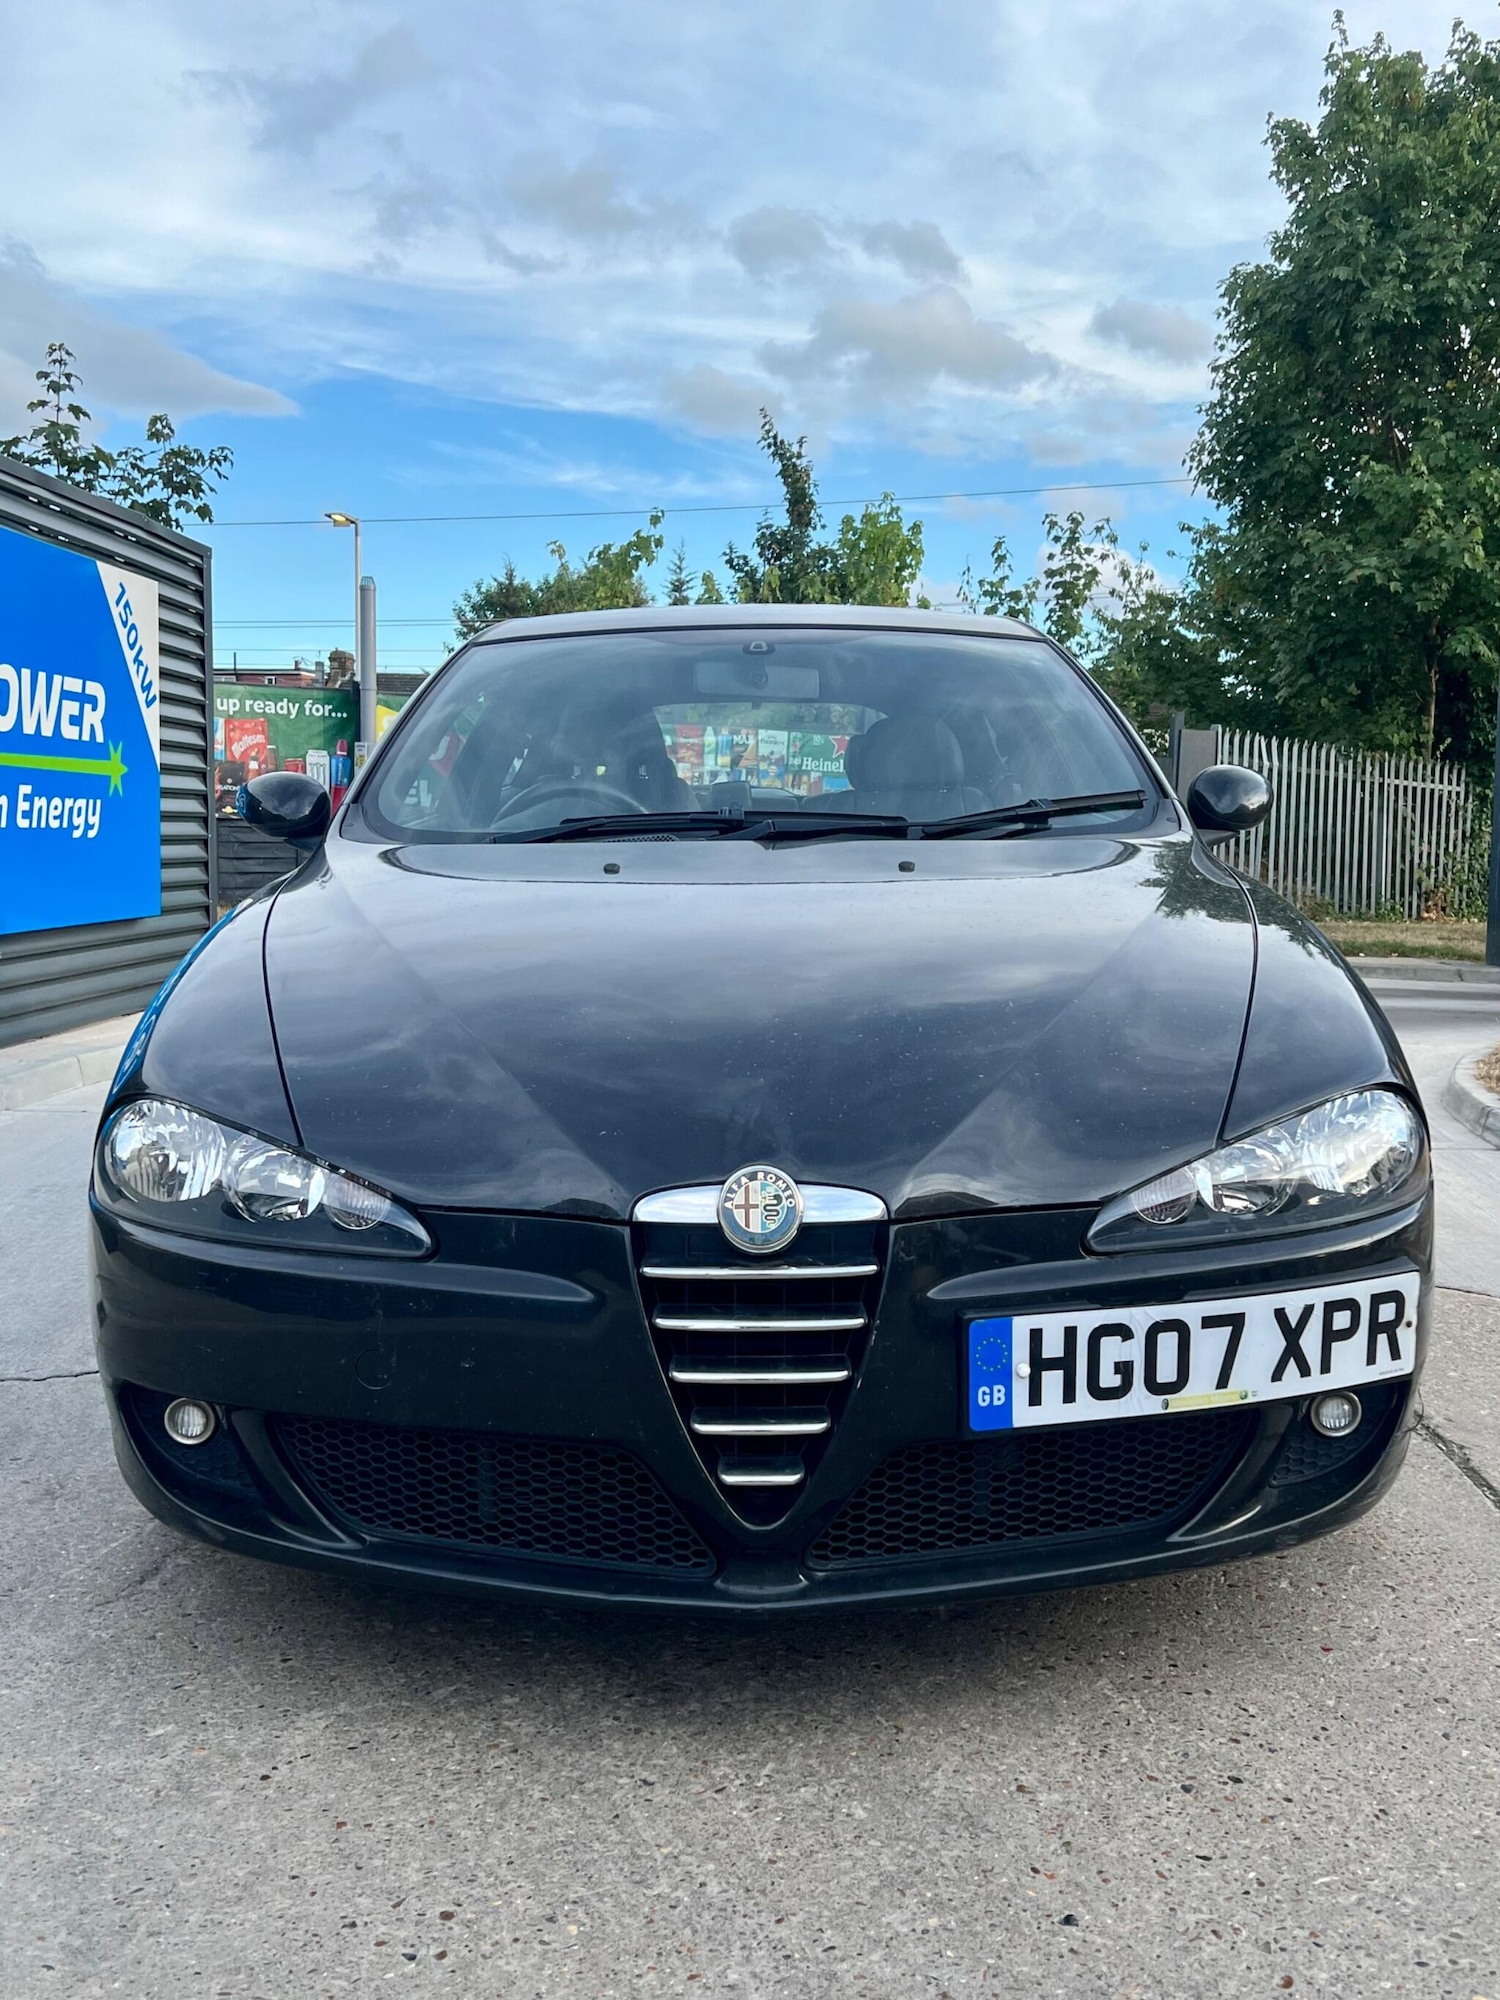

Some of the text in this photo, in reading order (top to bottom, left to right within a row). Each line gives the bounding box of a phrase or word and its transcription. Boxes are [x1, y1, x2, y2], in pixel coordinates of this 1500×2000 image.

[115, 581, 157, 709] 150kW
[216, 698, 348, 719] up ready for...
[801, 756, 844, 773] Heine
[16, 784, 102, 839] Energy
[724, 1171, 796, 1209] ALFA ROMEO
[1270, 1290, 1406, 1383] XPR
[977, 1384, 1006, 1408] GB
